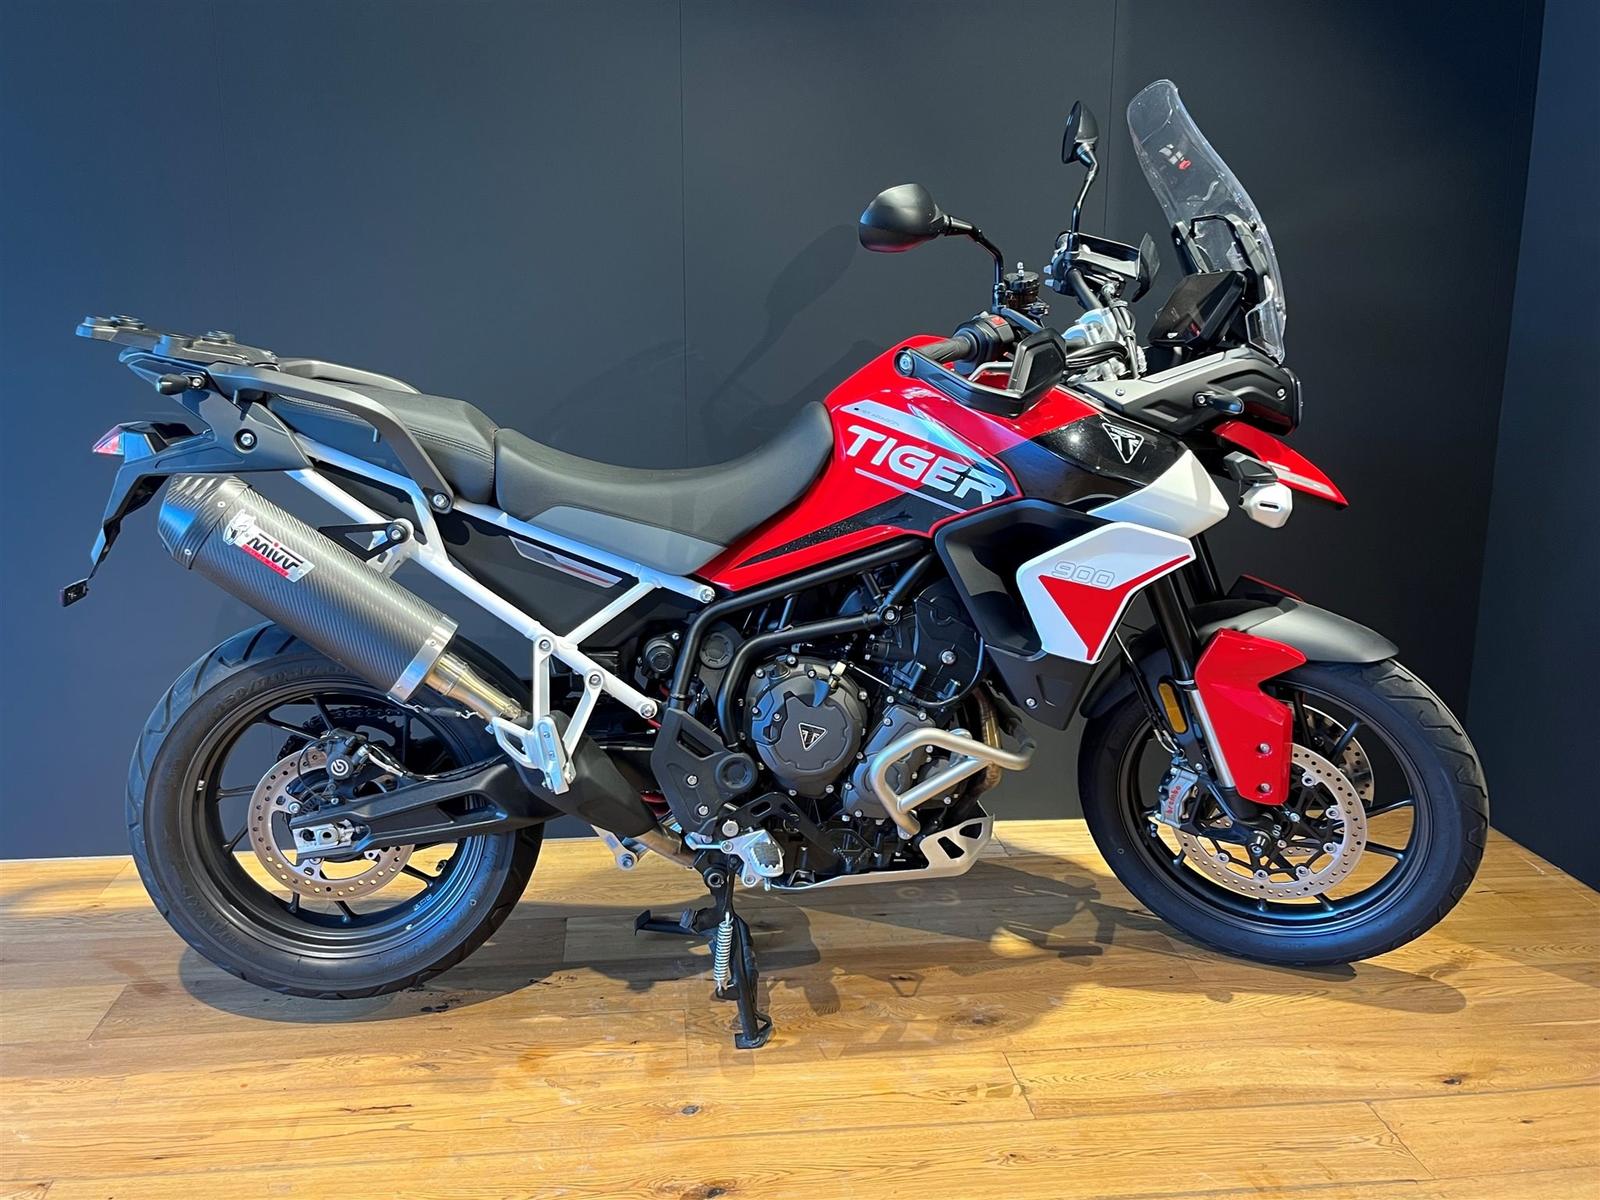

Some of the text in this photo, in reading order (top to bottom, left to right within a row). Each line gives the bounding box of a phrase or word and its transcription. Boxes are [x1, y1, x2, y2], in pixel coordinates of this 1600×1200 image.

[847, 424, 1007, 505] TIGER
[1051, 561, 1115, 588] 900
[1165, 785, 1182, 815] brembo
